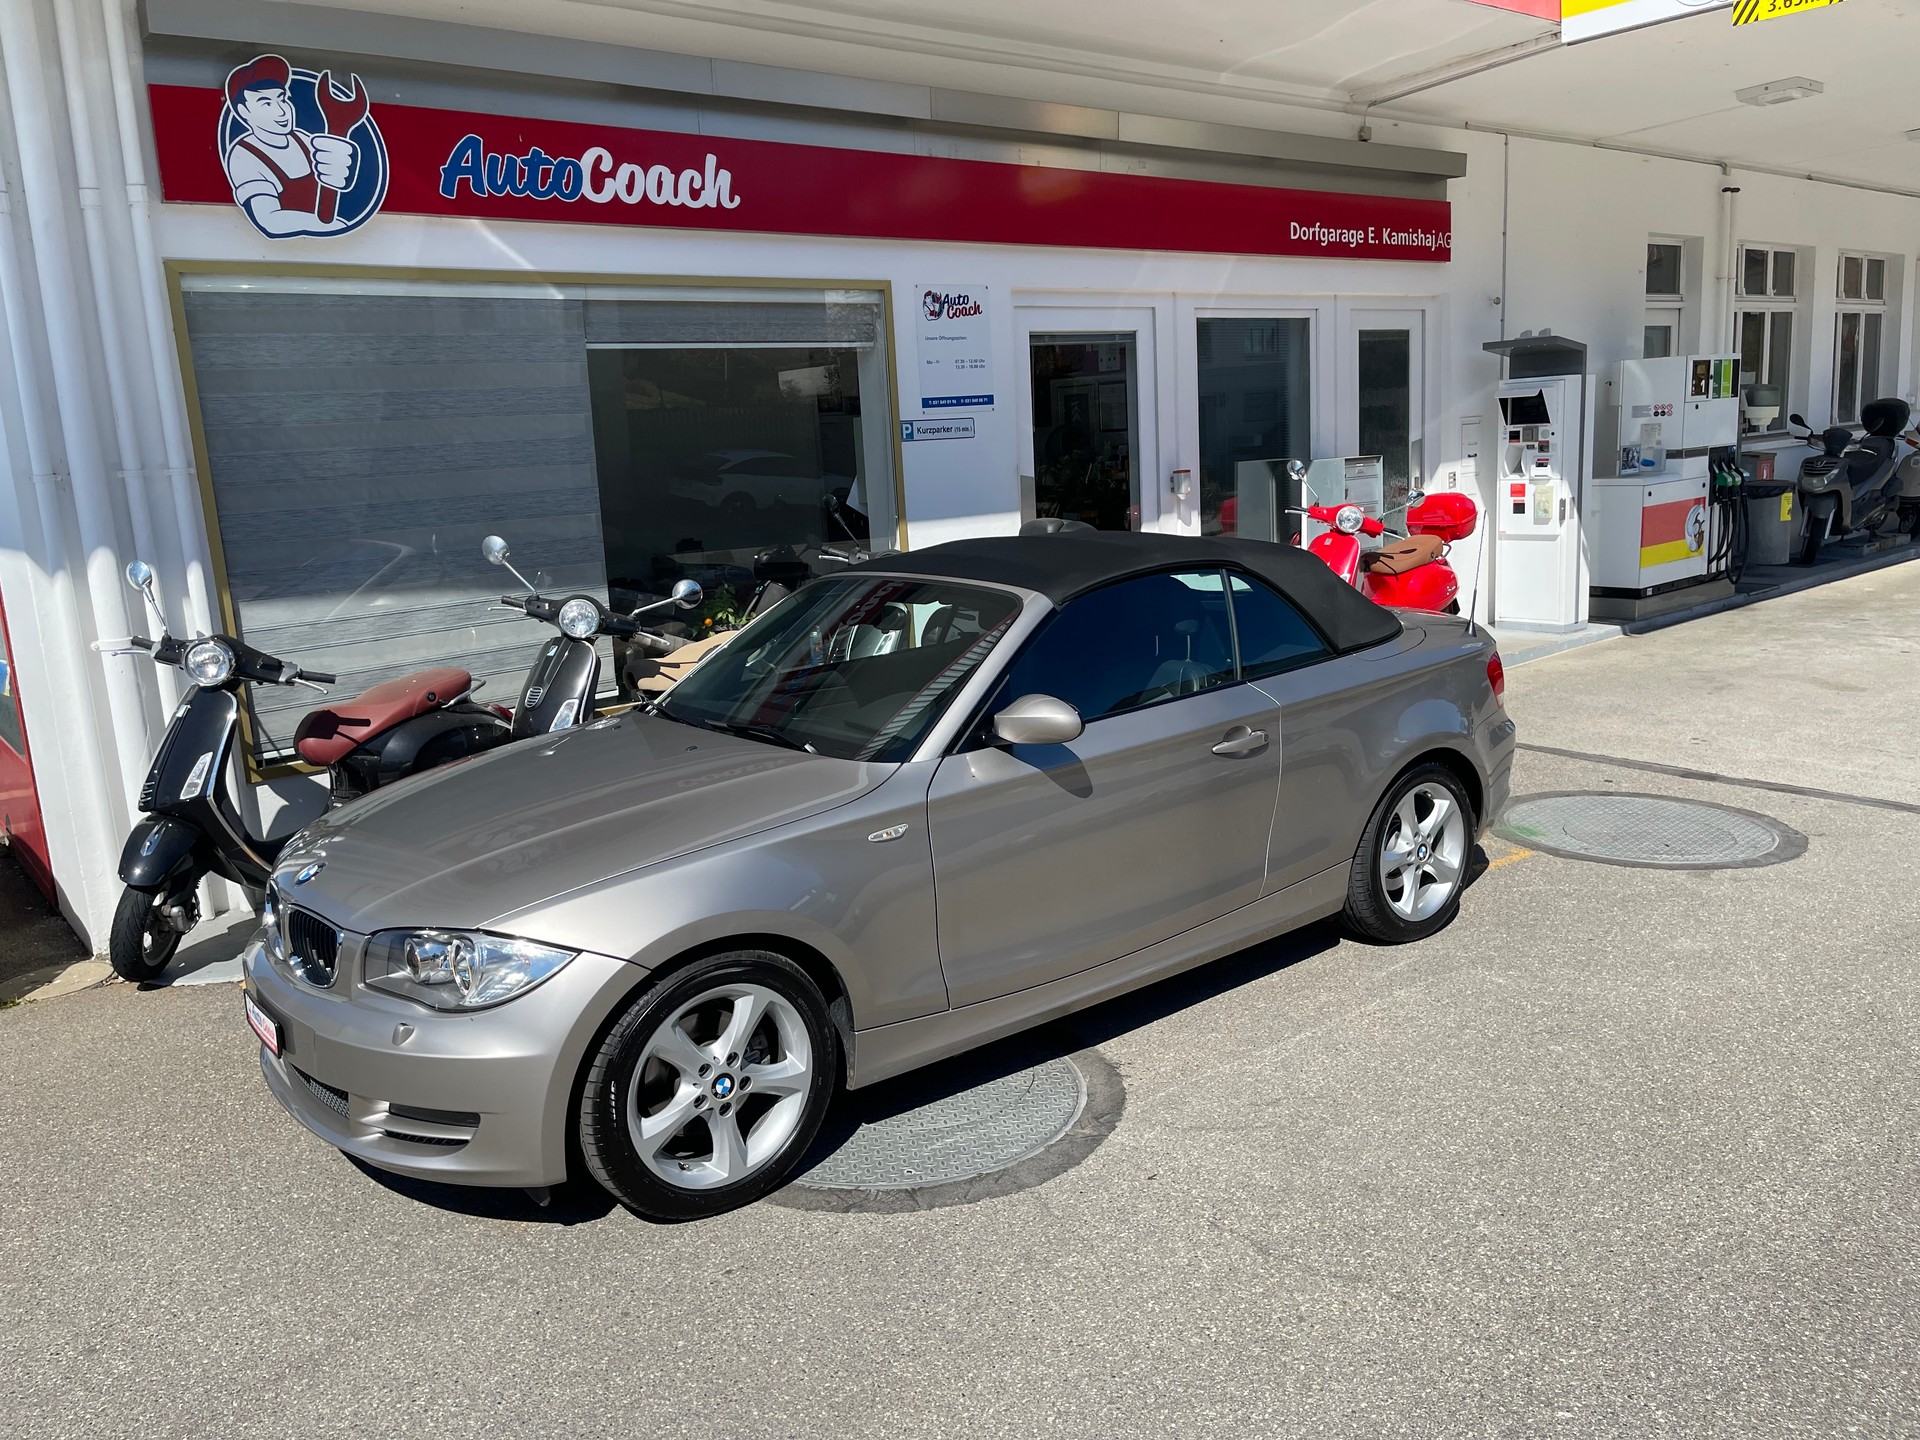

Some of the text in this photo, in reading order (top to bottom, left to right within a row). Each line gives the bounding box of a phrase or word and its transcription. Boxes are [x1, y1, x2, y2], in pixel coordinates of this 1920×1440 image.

[1768, 0, 1820, 12] 3.6
[1290, 221, 1365, 247] Dorfgarage
[1368, 227, 1379, 244] E.
[941, 293, 970, 310] Auto
[946, 300, 983, 320] Coach
[902, 423, 912, 439] P
[917, 426, 953, 436] Kurzparker
